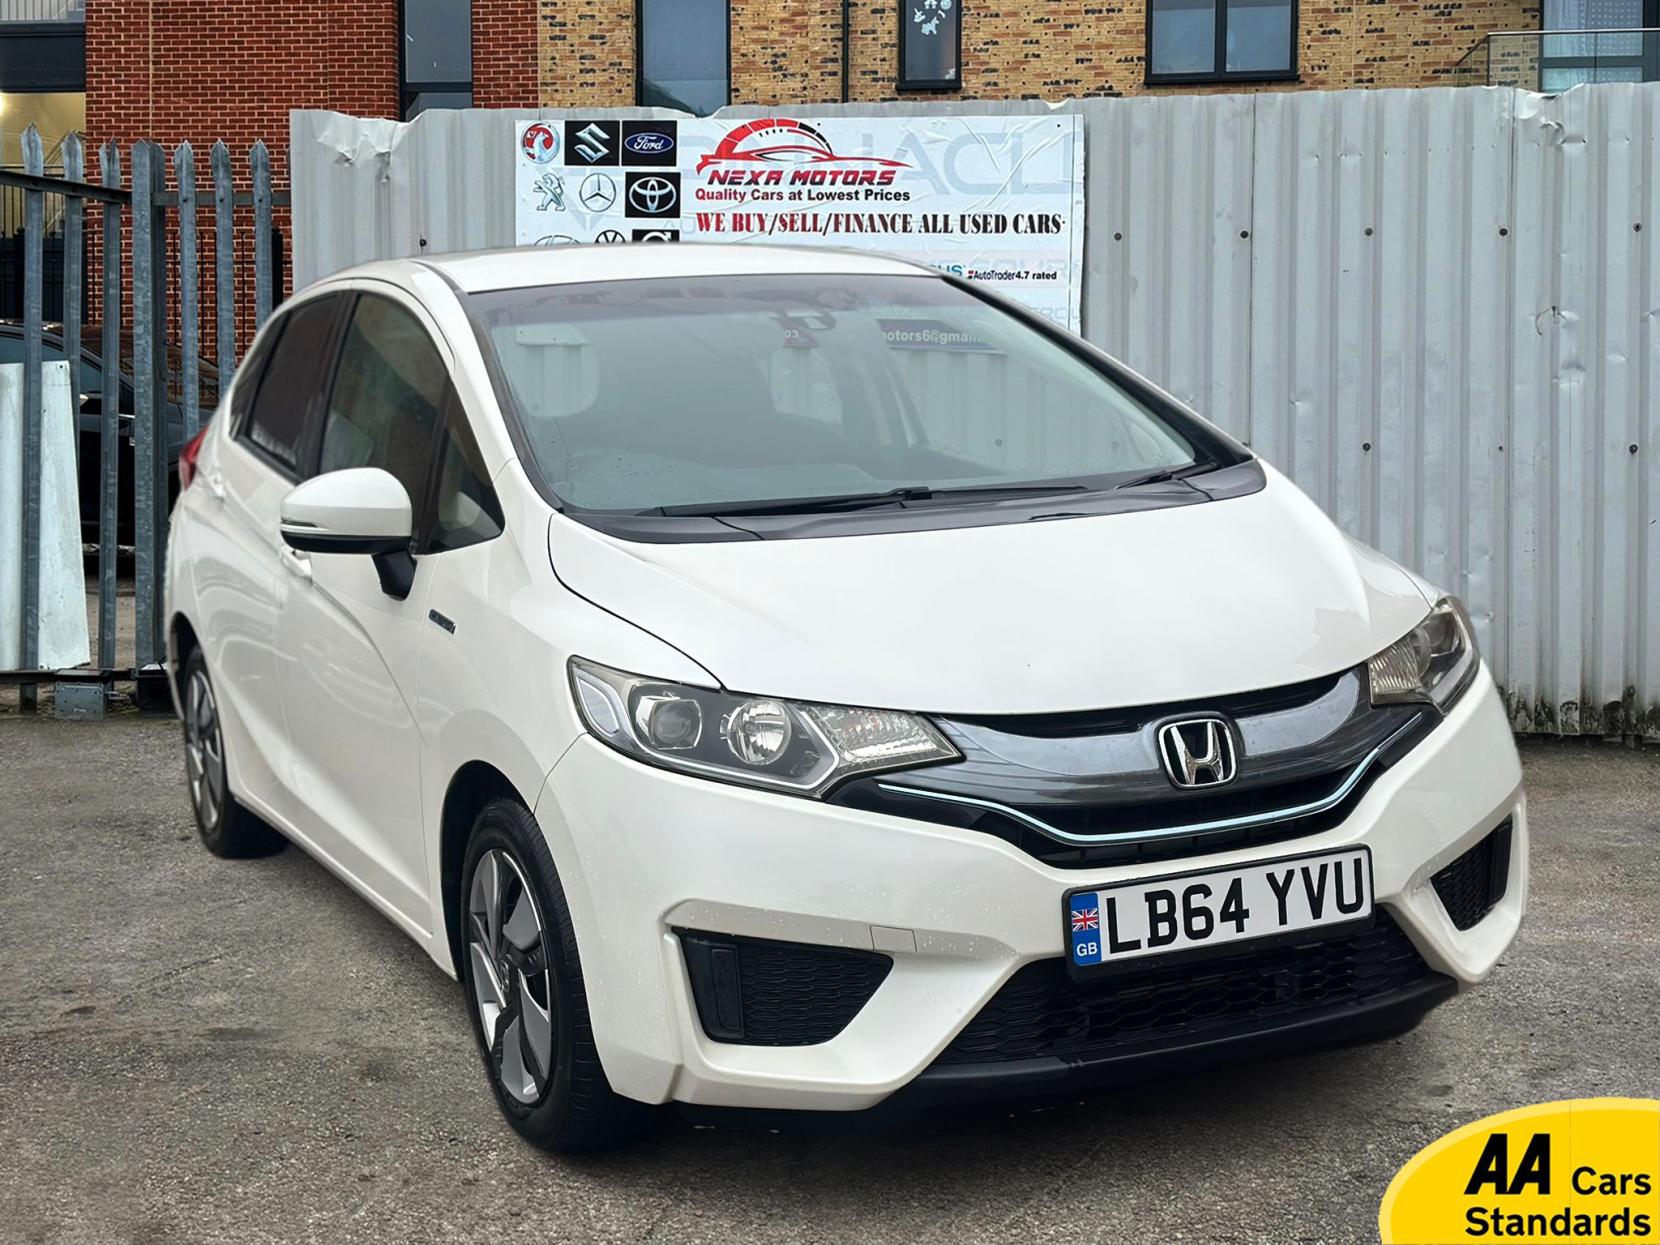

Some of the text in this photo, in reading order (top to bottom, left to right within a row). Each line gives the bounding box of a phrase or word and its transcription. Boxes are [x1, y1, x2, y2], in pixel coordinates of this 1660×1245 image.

[633, 136, 664, 150] Ford
[707, 169, 897, 186] NEXA MOTORS
[695, 188, 910, 203] Quality Cars at Lowest Prices
[696, 212, 726, 233] WE
[731, 212, 912, 236] BUY/SELL/FINANCE
[918, 213, 954, 234] ALL
[959, 213, 1008, 235] USED
[1032, 271, 1057, 280] rated
[1106, 857, 1365, 954] LB64 YVU
[1077, 942, 1098, 957] GB
